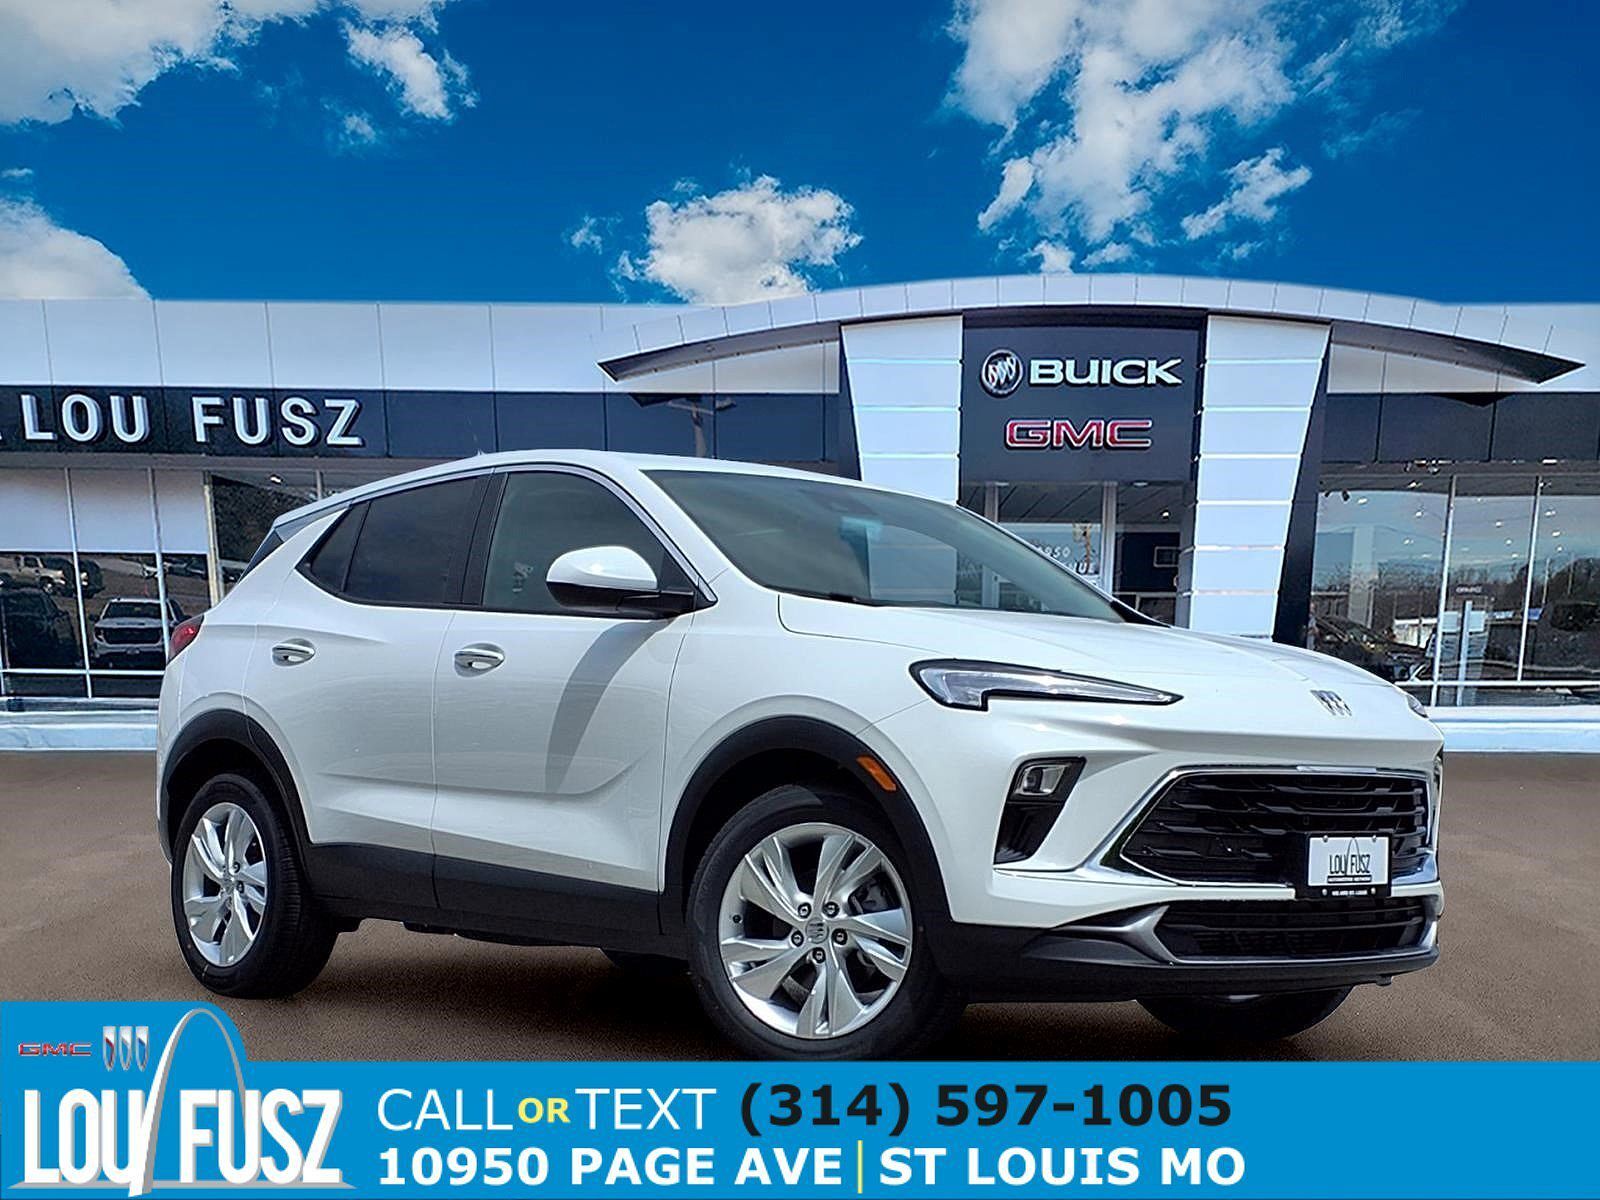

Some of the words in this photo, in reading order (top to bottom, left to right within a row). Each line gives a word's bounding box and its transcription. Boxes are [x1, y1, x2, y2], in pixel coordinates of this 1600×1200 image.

[1029, 358, 1182, 385] BUICK
[20, 394, 151, 443] LOU
[192, 396, 365, 447] FUSZ
[1005, 419, 1153, 448] GMC
